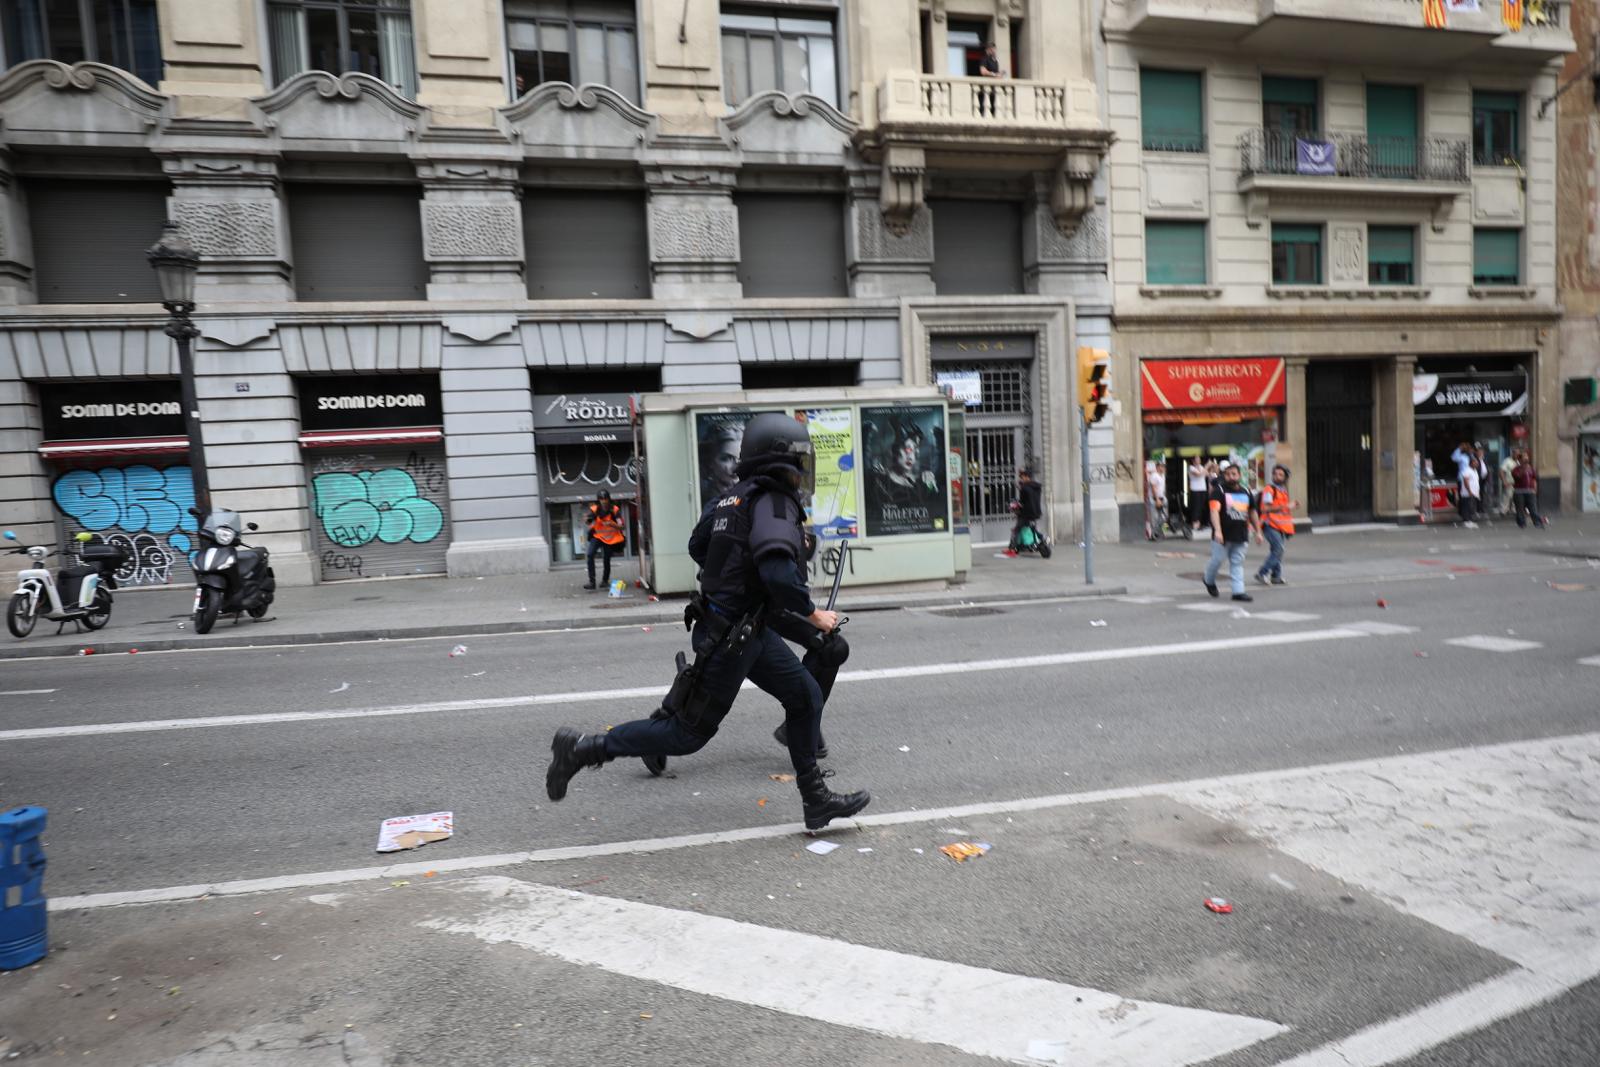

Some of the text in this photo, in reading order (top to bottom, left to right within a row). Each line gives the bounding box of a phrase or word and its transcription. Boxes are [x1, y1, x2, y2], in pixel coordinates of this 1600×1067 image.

[1168, 363, 1262, 379] SUPERMERCATS
[318, 394, 426, 409] SOMNI DE DONA
[1446, 390, 1482, 404] SUPER
[61, 402, 182, 418] SOMNI DE DONA
